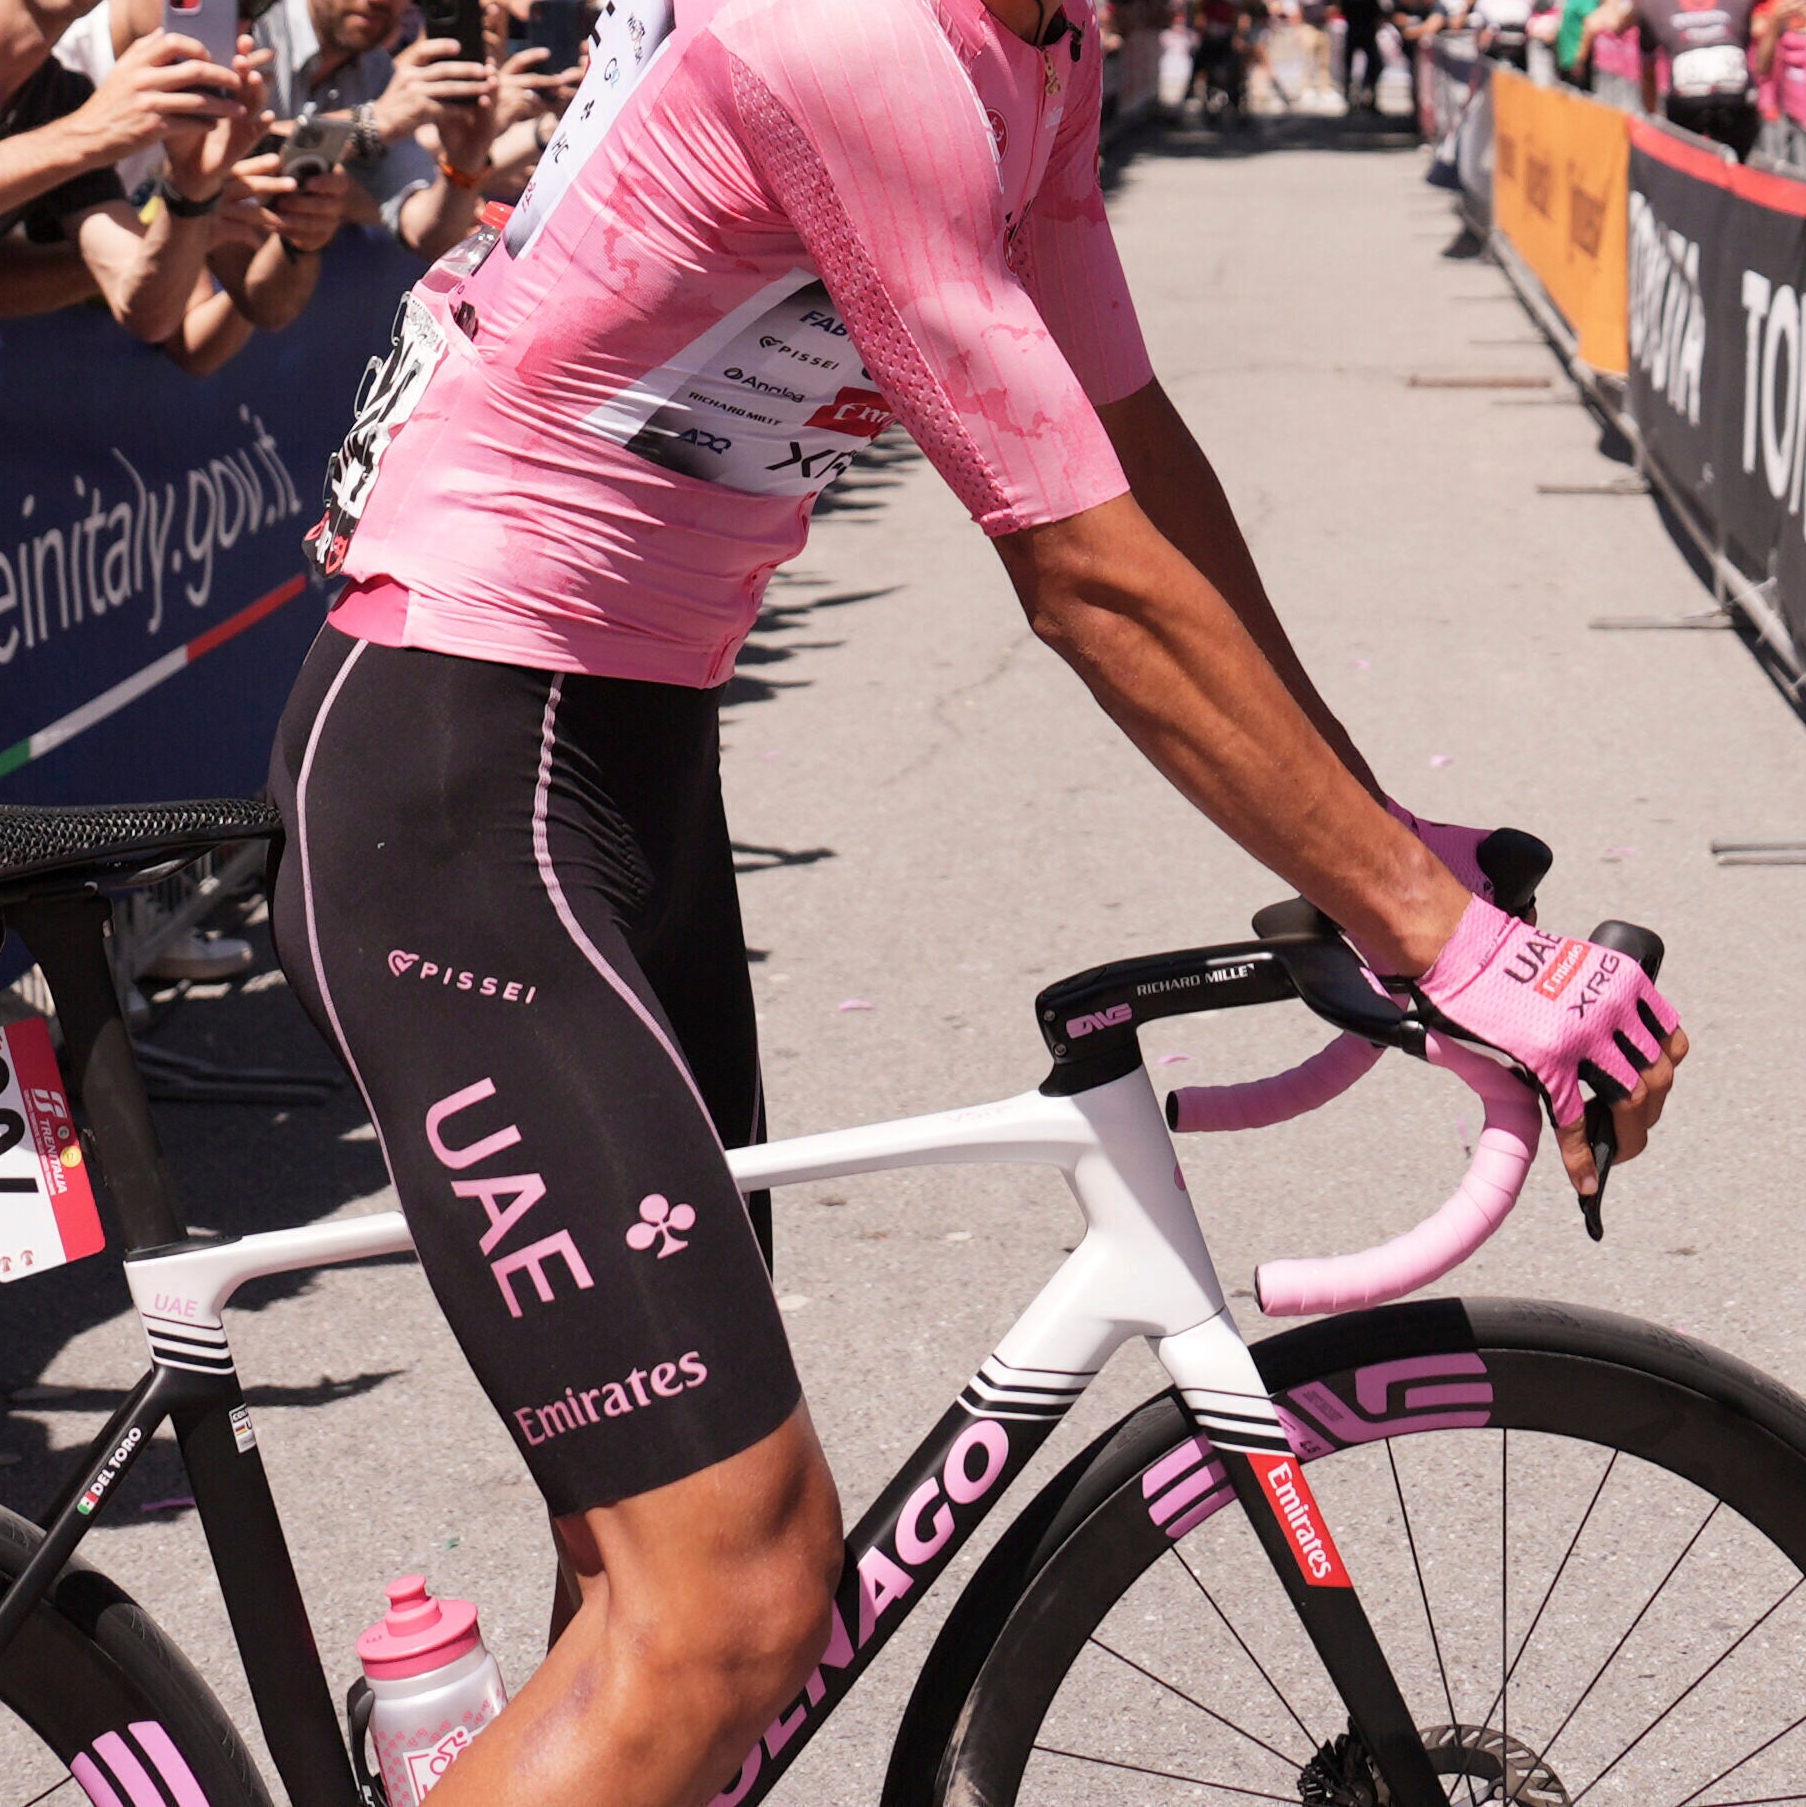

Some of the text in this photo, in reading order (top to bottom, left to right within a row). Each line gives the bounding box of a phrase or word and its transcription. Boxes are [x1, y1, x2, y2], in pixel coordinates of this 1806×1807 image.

[778, 345, 840, 371] PISSEI
[741, 376, 805, 403] Analog
[420, 961, 537, 1005] PISSEI
[1136, 965, 1249, 996] RICHARD MILLE
[1503, 930, 1563, 984] UAE
[1567, 953, 1620, 1019] XRG
[39, 1118, 68, 1195] TRENITALIA
[424, 1076, 596, 1319] UAE
[154, 1293, 199, 1318] UAE
[513, 1350, 709, 1447] Emirates
[90, 1425, 144, 1497] DEL TORO
[1267, 1463, 1333, 1580] Emirates
